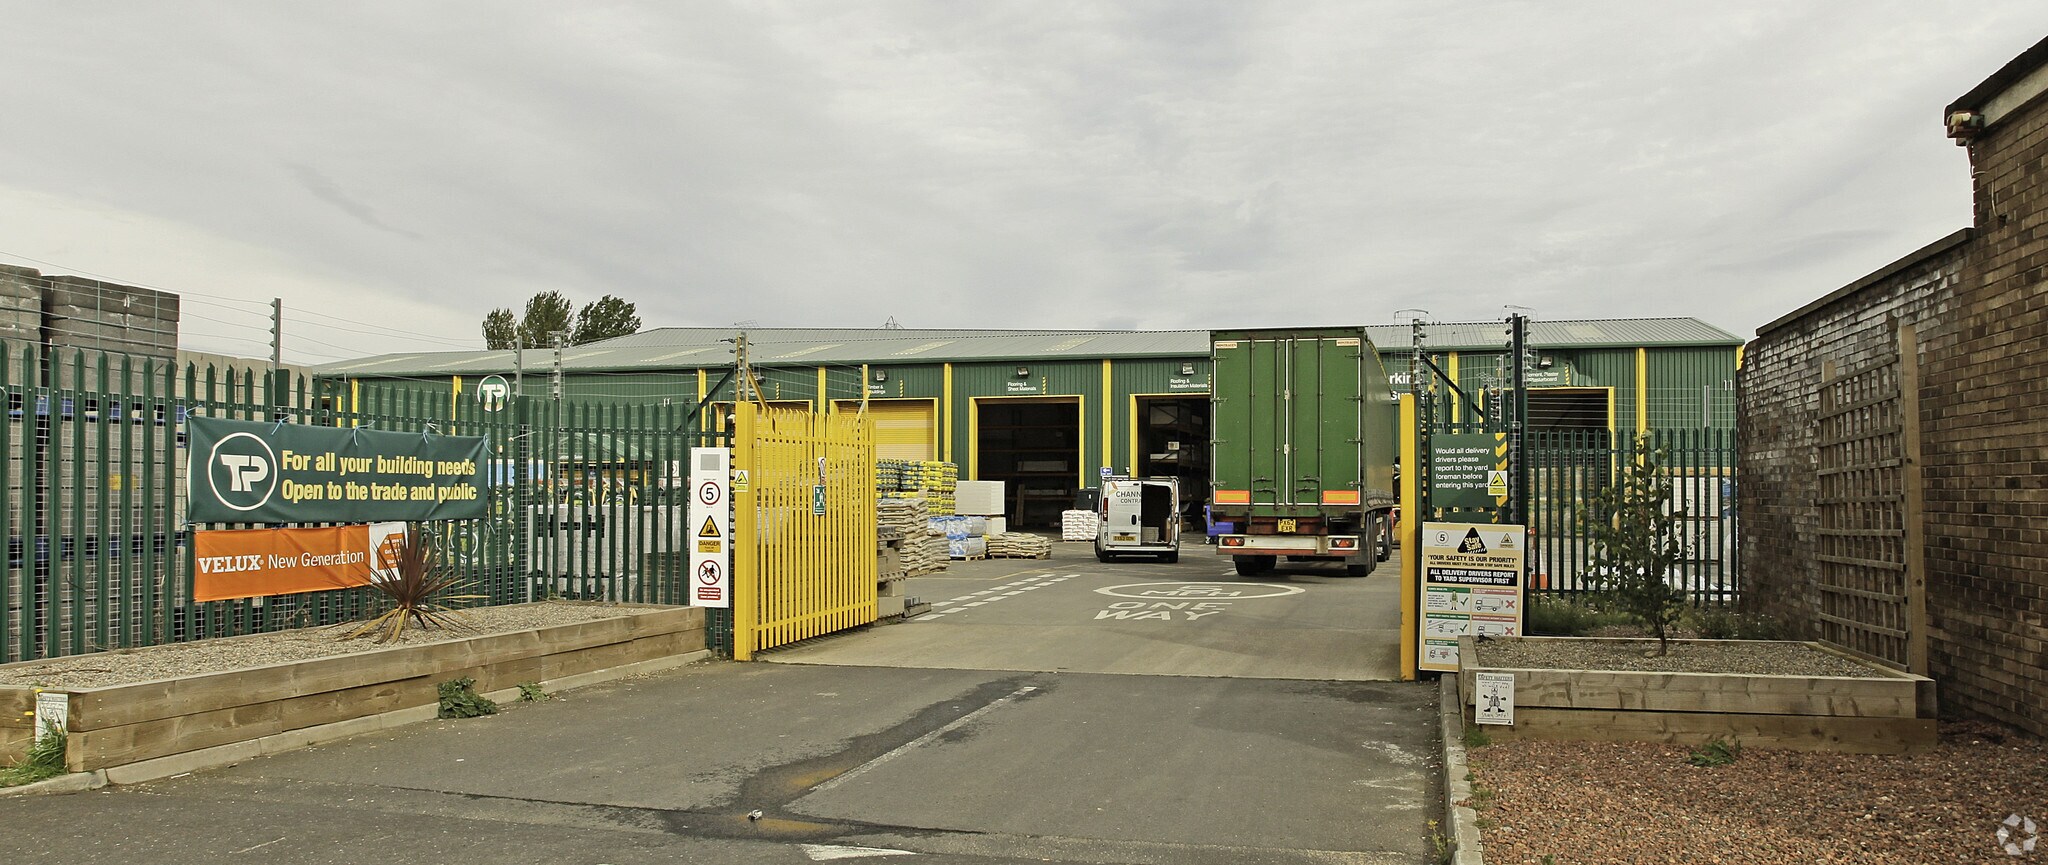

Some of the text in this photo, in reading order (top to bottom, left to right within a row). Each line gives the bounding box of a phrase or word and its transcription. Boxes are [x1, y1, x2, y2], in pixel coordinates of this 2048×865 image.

[1465, 447, 1490, 455] delivery
[282, 450, 476, 479] For all your building needs
[220, 454, 269, 492] TP
[1435, 482, 1461, 490] entering
[282, 479, 477, 504] Open to the trade and public
[705, 487, 714, 500] 5
[1464, 536, 1480, 545] Stay
[1466, 543, 1482, 551] Safe
[268, 553, 298, 570] New
[301, 549, 364, 568] Generation
[1458, 576, 1492, 584] SUPERVISOR
[1108, 601, 1232, 610] ONE
[1093, 610, 1220, 620] WAY
